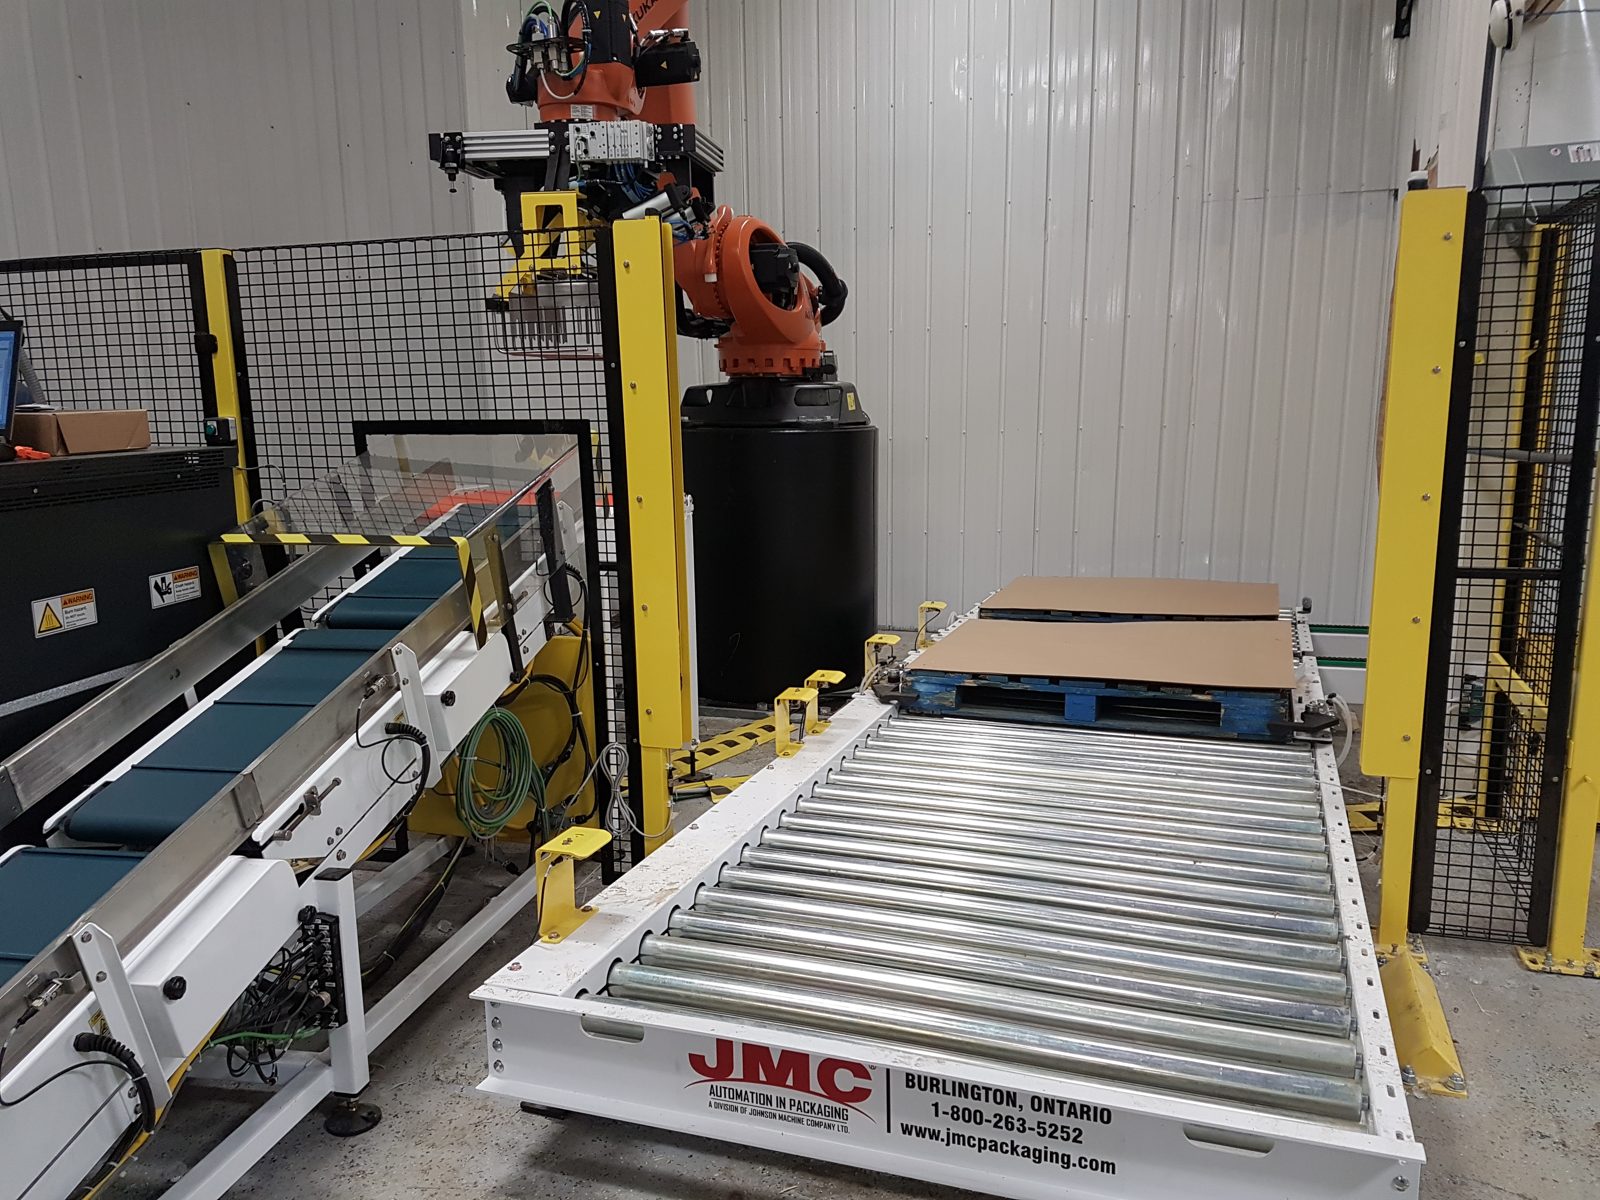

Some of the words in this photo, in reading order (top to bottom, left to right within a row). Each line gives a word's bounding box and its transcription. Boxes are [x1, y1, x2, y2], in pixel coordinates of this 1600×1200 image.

[688, 1038, 872, 1103] JMC
[709, 1085, 773, 1105] AUTOMATION
[775, 1096, 786, 1109] IN
[789, 1098, 849, 1121] PACKAGING
[713, 1102, 739, 1113] DIVISION
[740, 1106, 748, 1115] OF
[749, 1108, 777, 1120] JOHNSON
[778, 1113, 805, 1126] MACHINE
[806, 1118, 836, 1131] COMPANY
[837, 1123, 850, 1134] LTD.
[905, 1072, 1024, 1112] BURLINGTON,
[1030, 1095, 1112, 1125] ONTARIO
[931, 1102, 1083, 1145] 1-800-263-5252
[900, 1122, 1116, 1175] www.jmcpackaging.com
